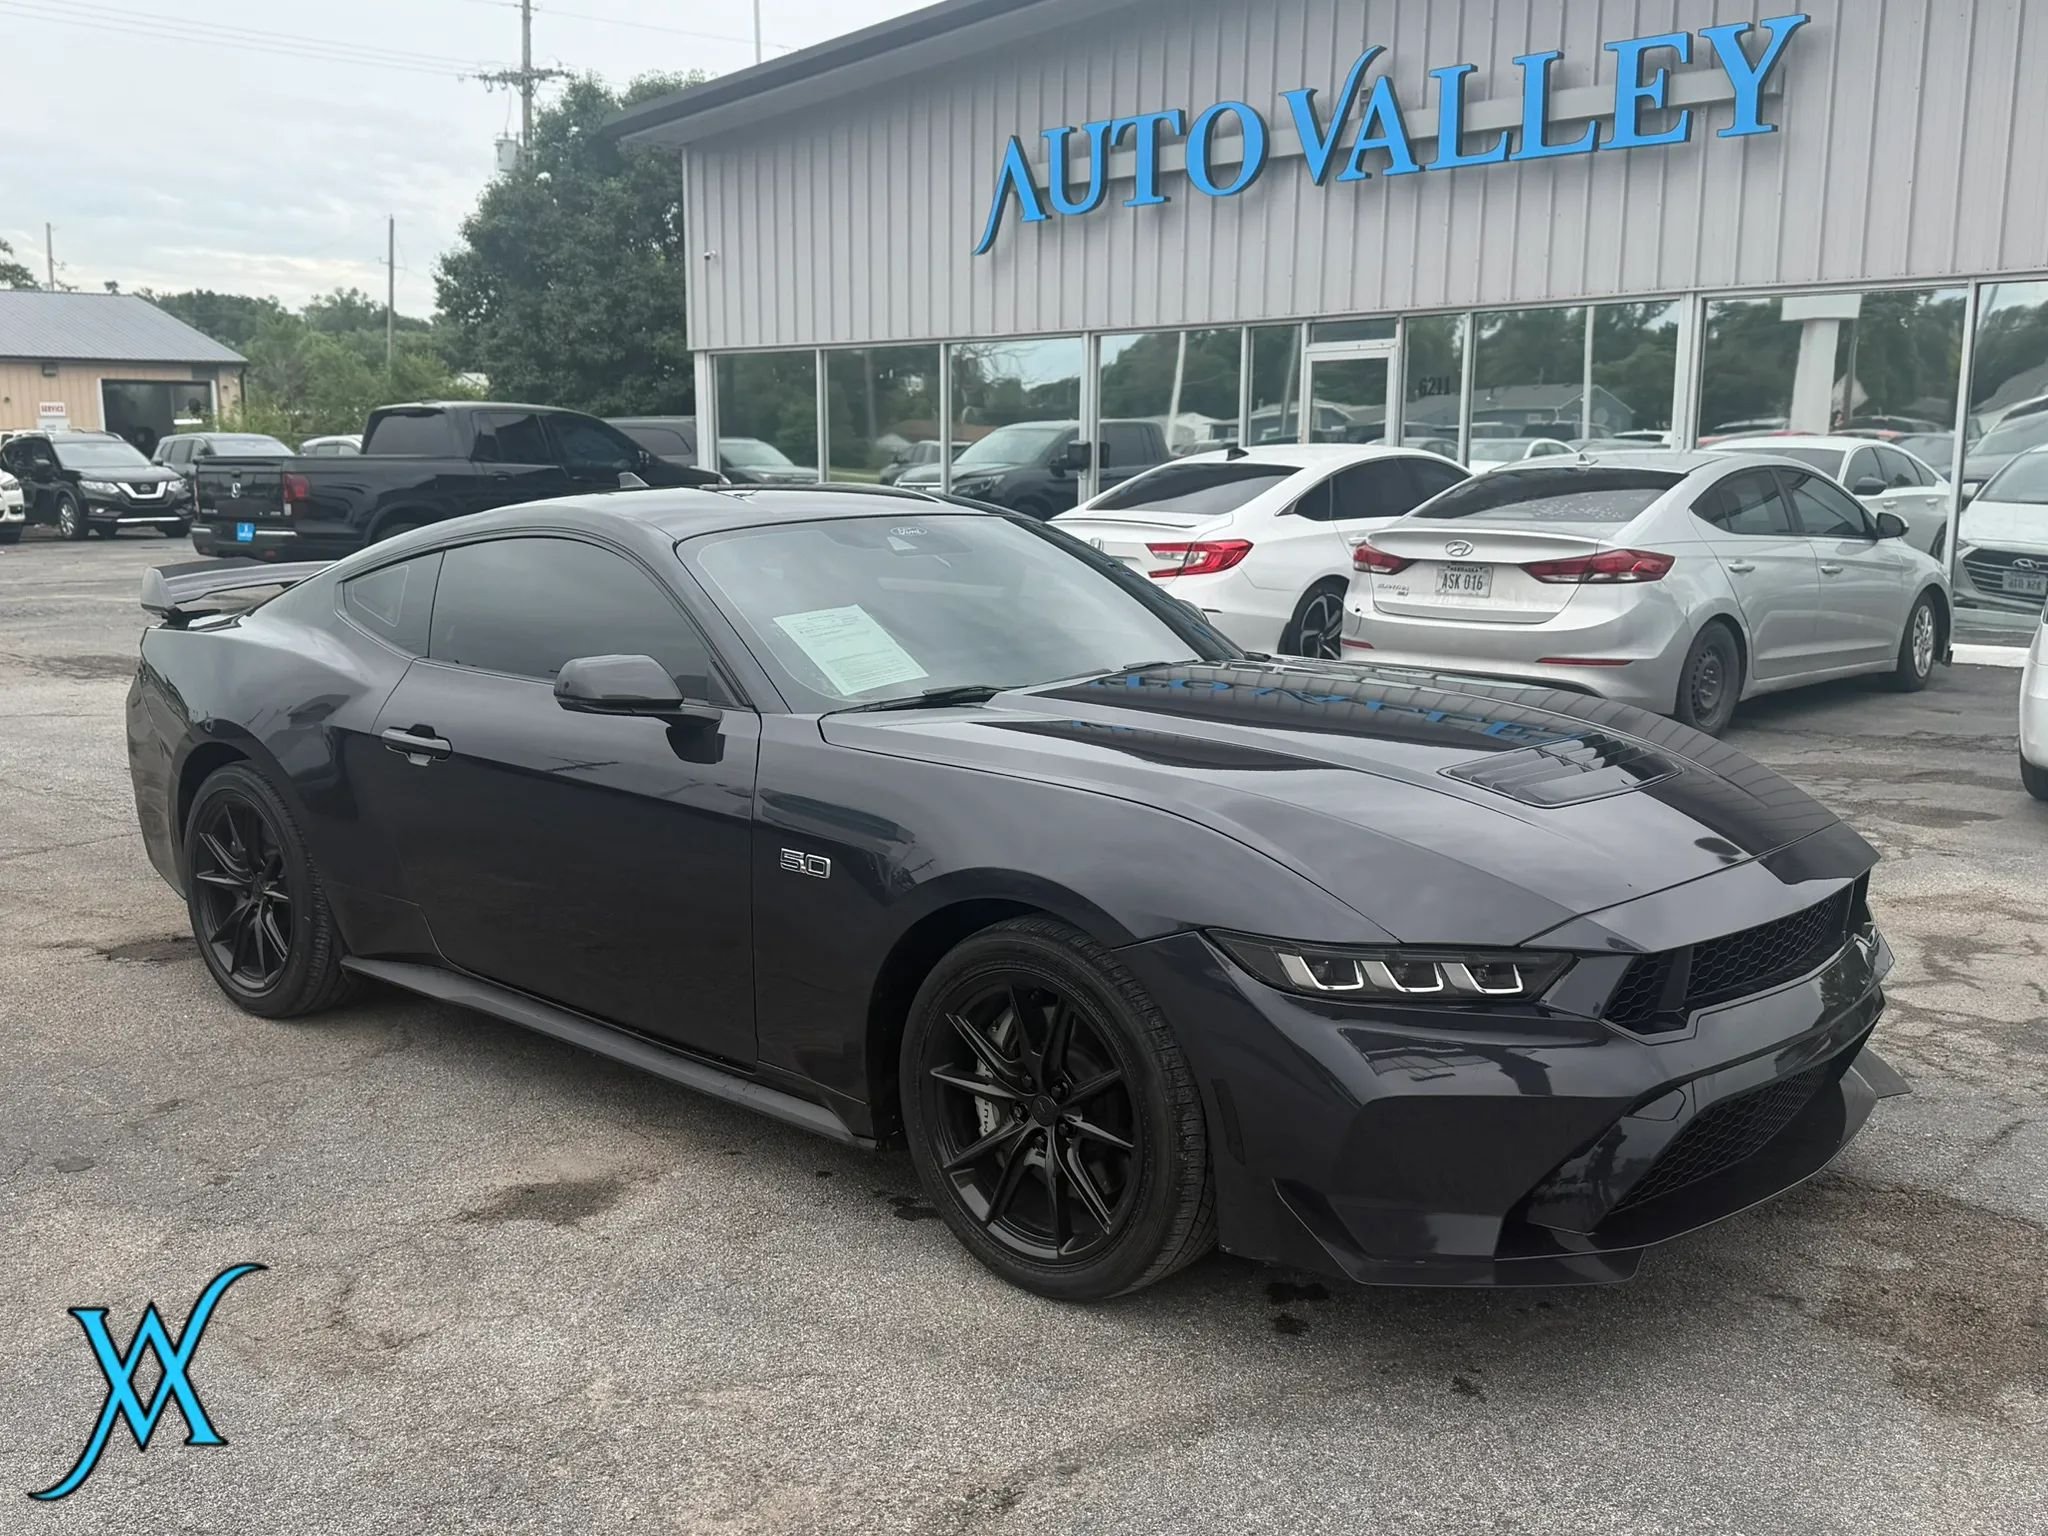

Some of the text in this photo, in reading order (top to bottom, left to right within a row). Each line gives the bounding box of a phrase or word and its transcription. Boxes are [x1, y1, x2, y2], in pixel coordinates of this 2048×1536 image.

[972, 14, 1809, 257] AUTO VALLEY
[1418, 376, 1450, 397] 6211
[1441, 573, 1483, 591] ASK 016
[780, 847, 832, 879] 5.0
